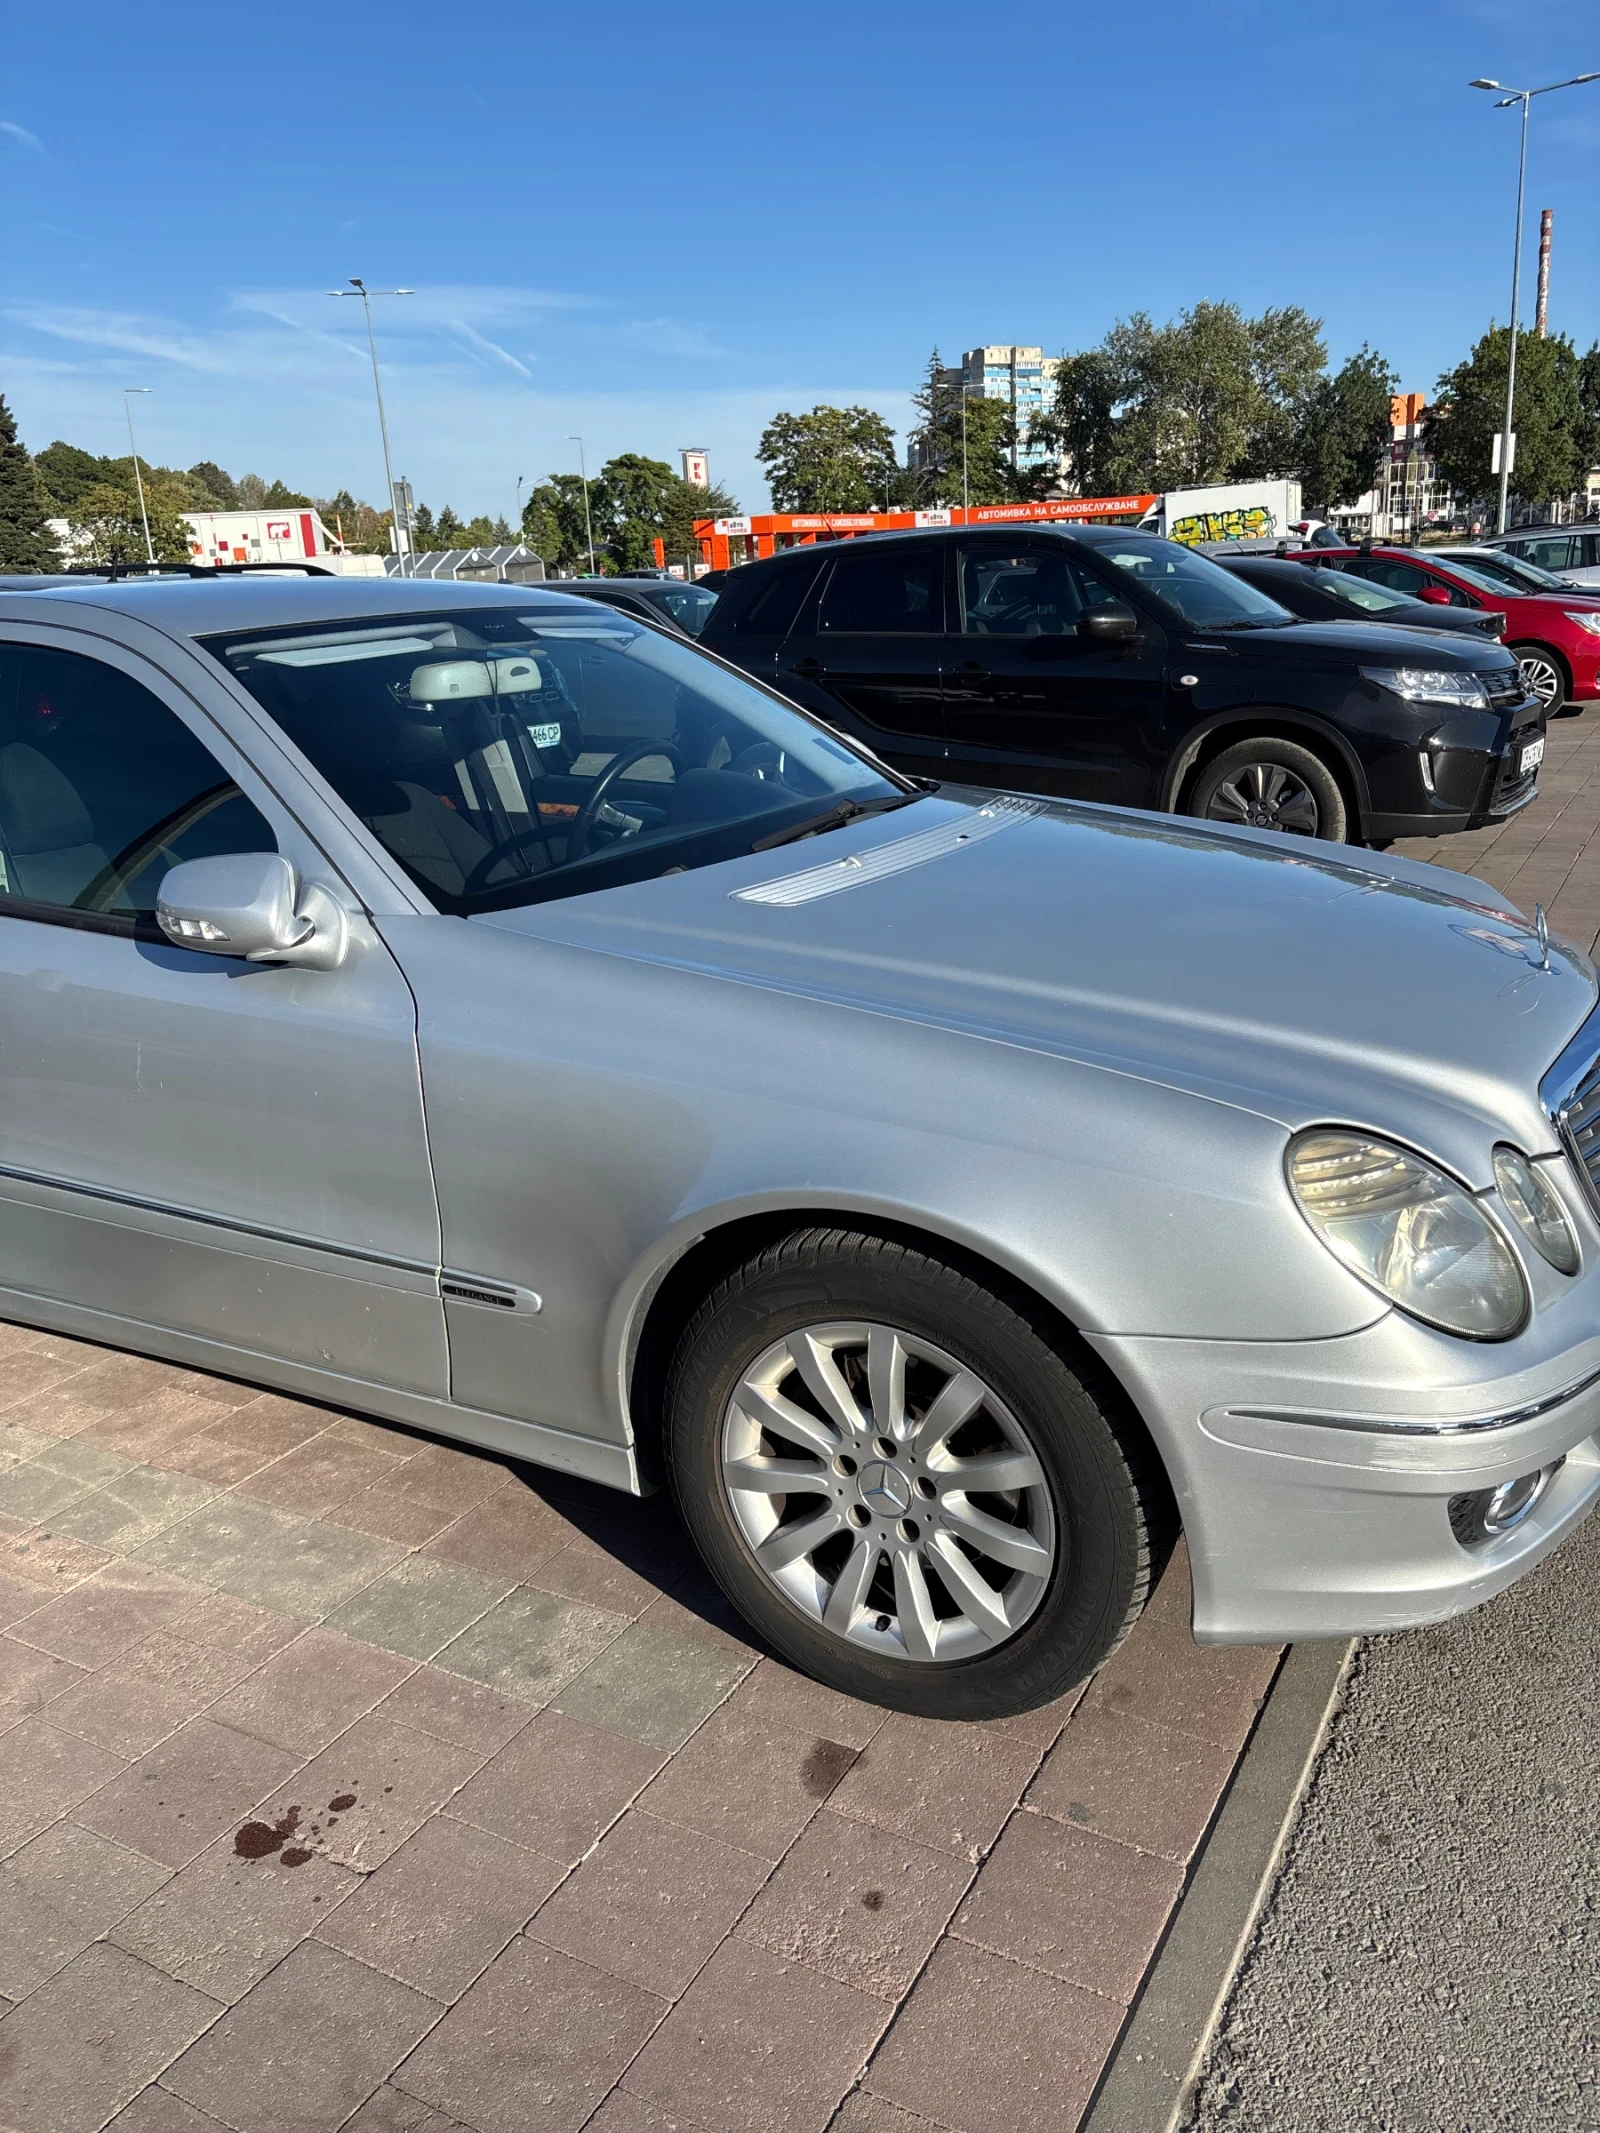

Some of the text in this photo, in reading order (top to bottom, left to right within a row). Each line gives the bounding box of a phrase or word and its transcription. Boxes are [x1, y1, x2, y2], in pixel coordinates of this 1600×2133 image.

[977, 500, 1139, 520] АВТОМИВКА НА САМООБСЛУЖВАНЕ
[529, 726, 559, 742] 466 CP
[455, 1288, 501, 1304] ELEGANCE
[675, 1355, 708, 1449] ULTRA
[702, 1312, 733, 1357] GRIP
[1016, 1554, 1105, 1692] GOODYEAR
